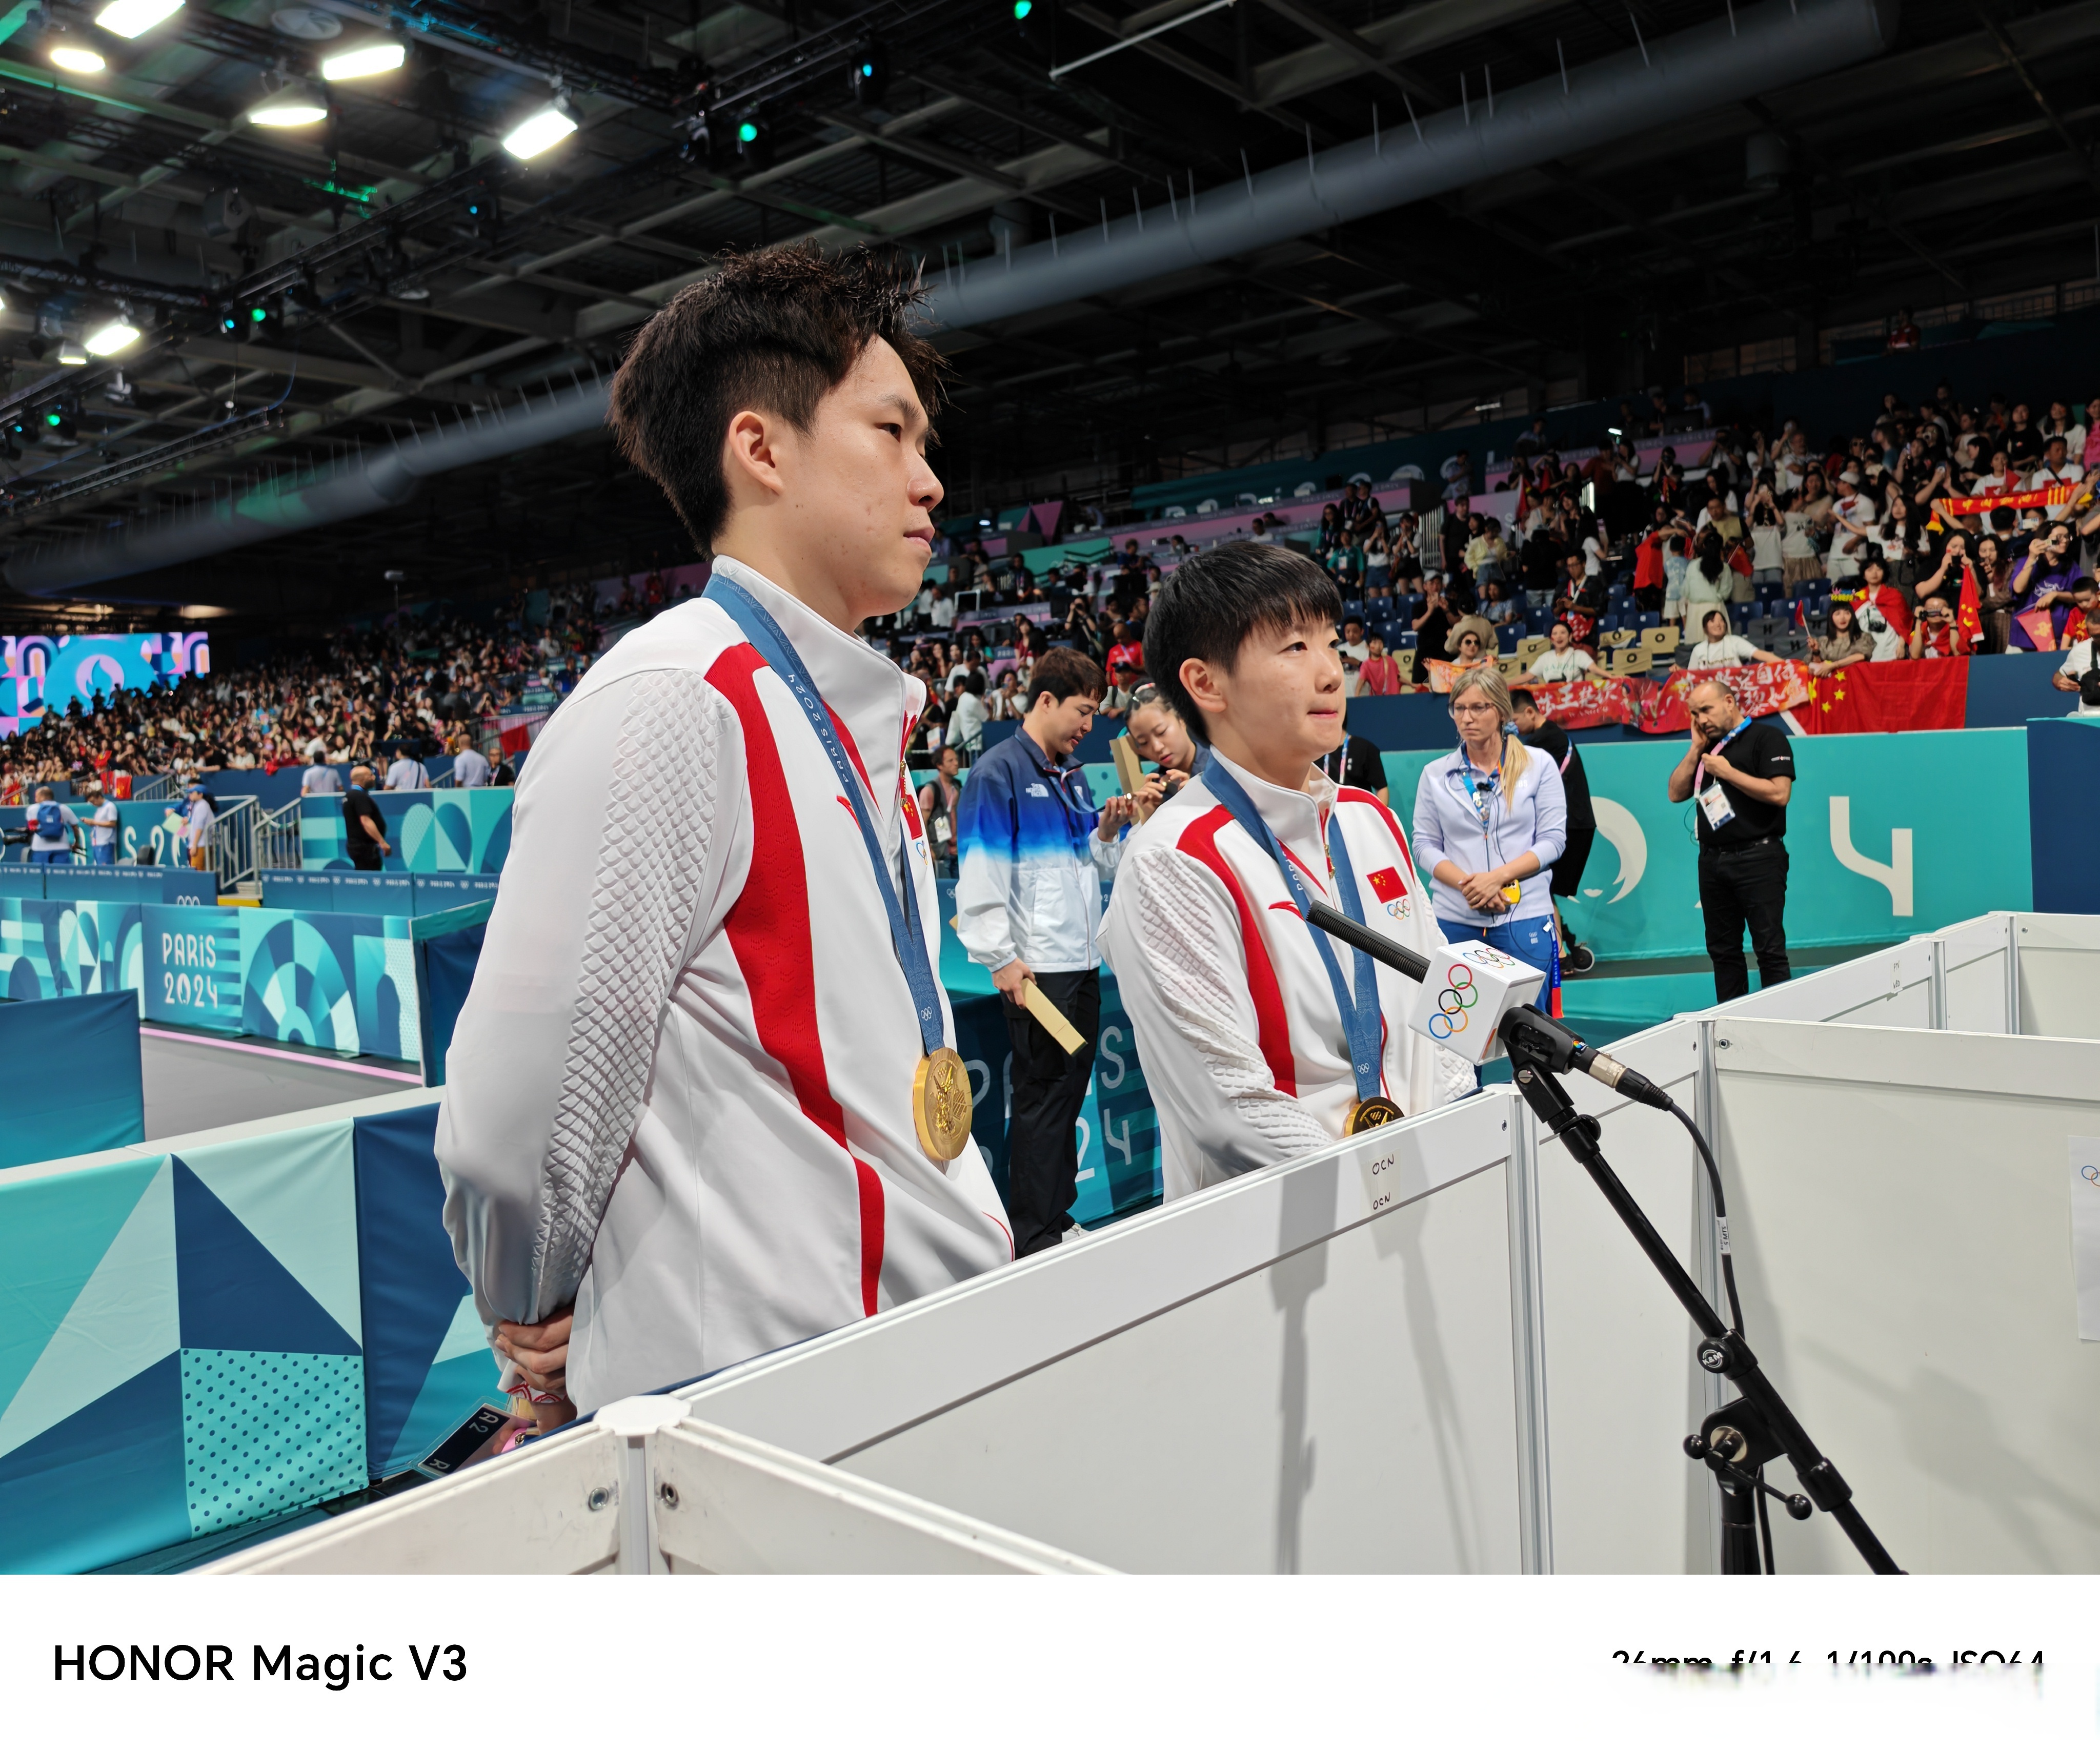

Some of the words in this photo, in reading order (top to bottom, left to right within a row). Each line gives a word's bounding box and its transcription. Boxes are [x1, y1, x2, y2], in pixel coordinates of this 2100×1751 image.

[164, 971, 218, 1009] 2024
[1372, 1153, 1394, 1175] OCN
[1373, 1192, 1390, 1210] OCN
[1702, 1352, 1724, 1365] K&M
